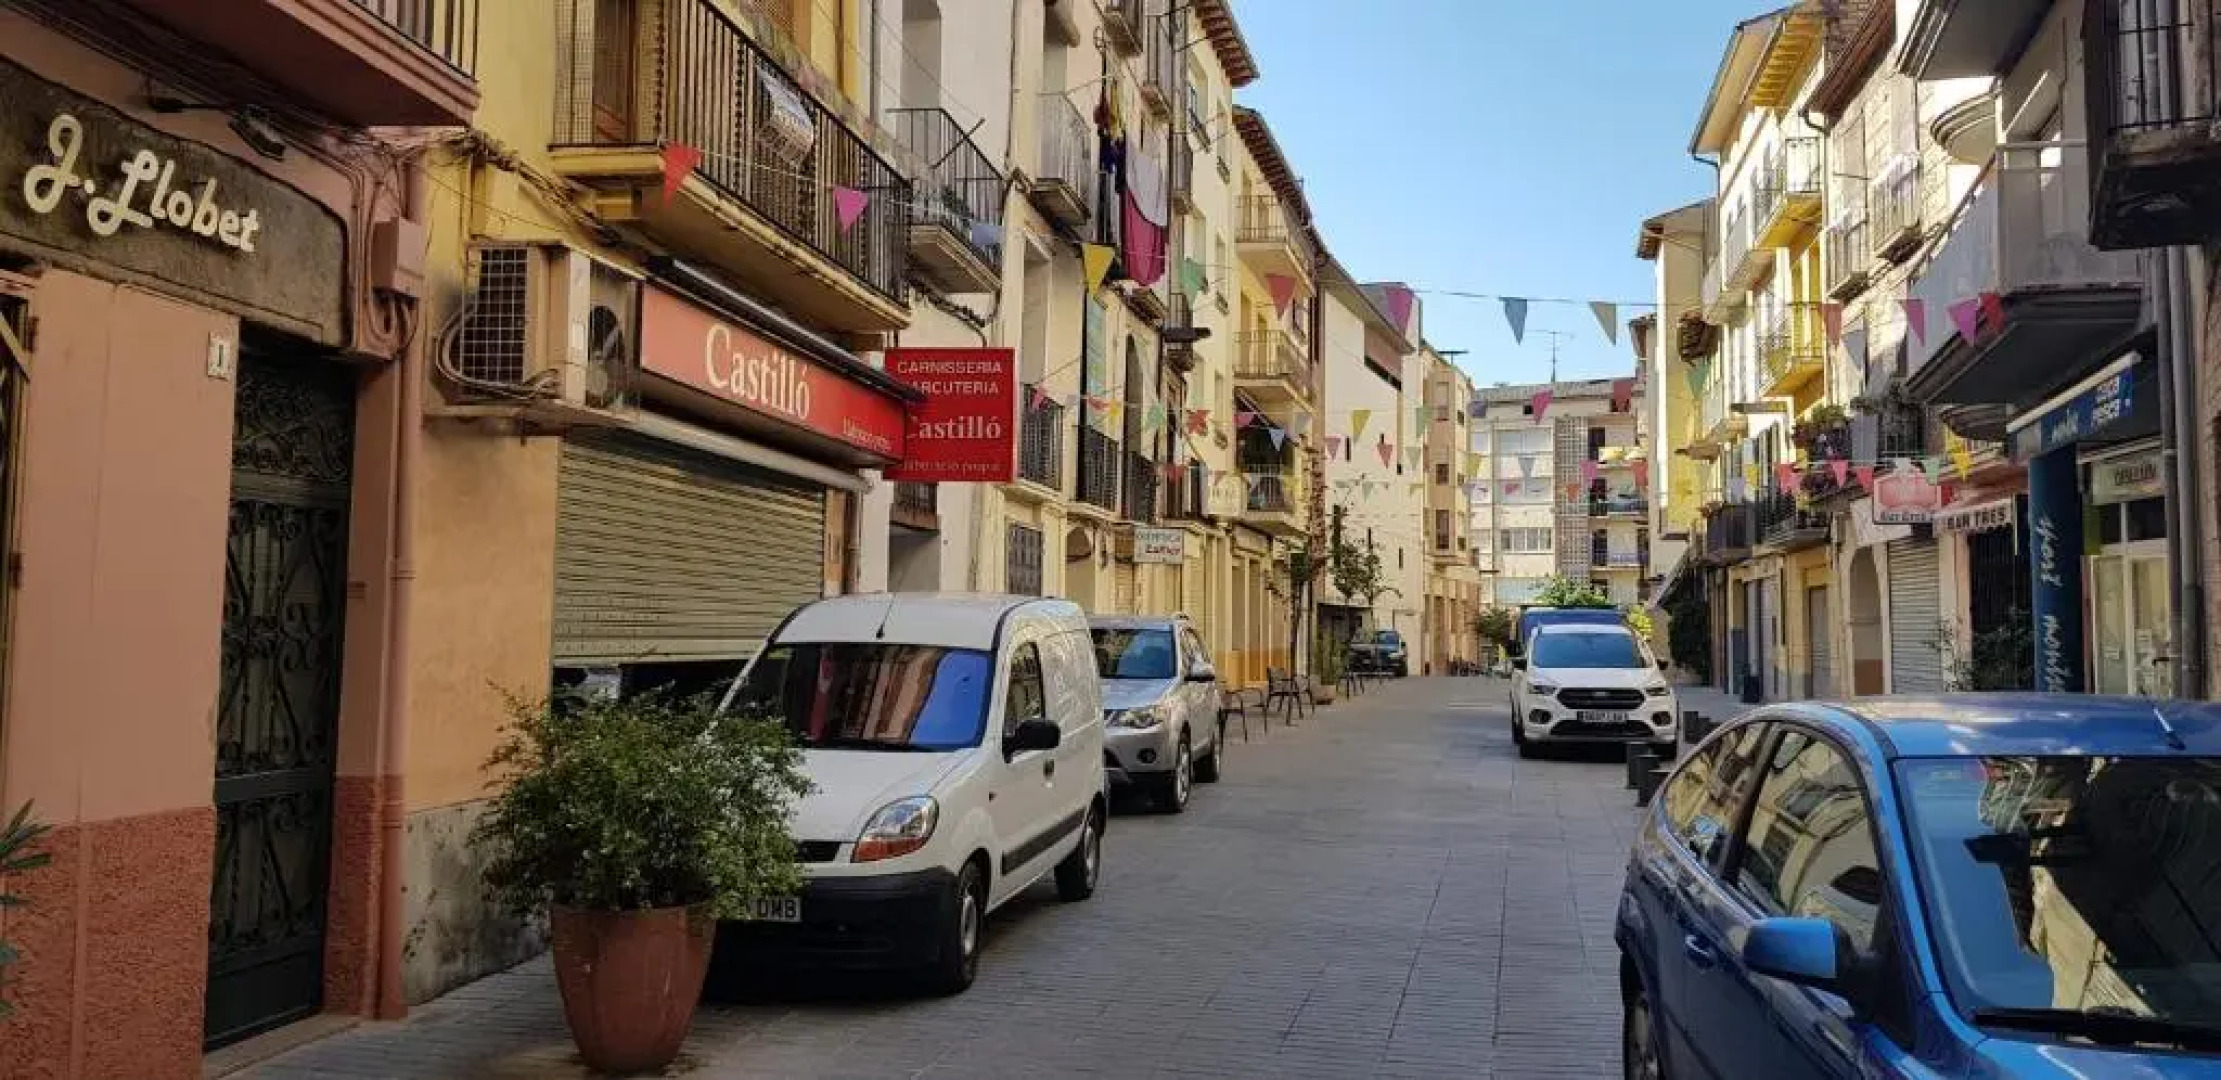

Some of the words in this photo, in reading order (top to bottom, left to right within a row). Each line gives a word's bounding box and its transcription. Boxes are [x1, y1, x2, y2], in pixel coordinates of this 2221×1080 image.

[87, 149, 260, 253] Llobet
[706, 323, 811, 420] Castilló
[897, 360, 1003, 374] CARNISSERIA
[905, 380, 999, 395] ARCUTERIA
